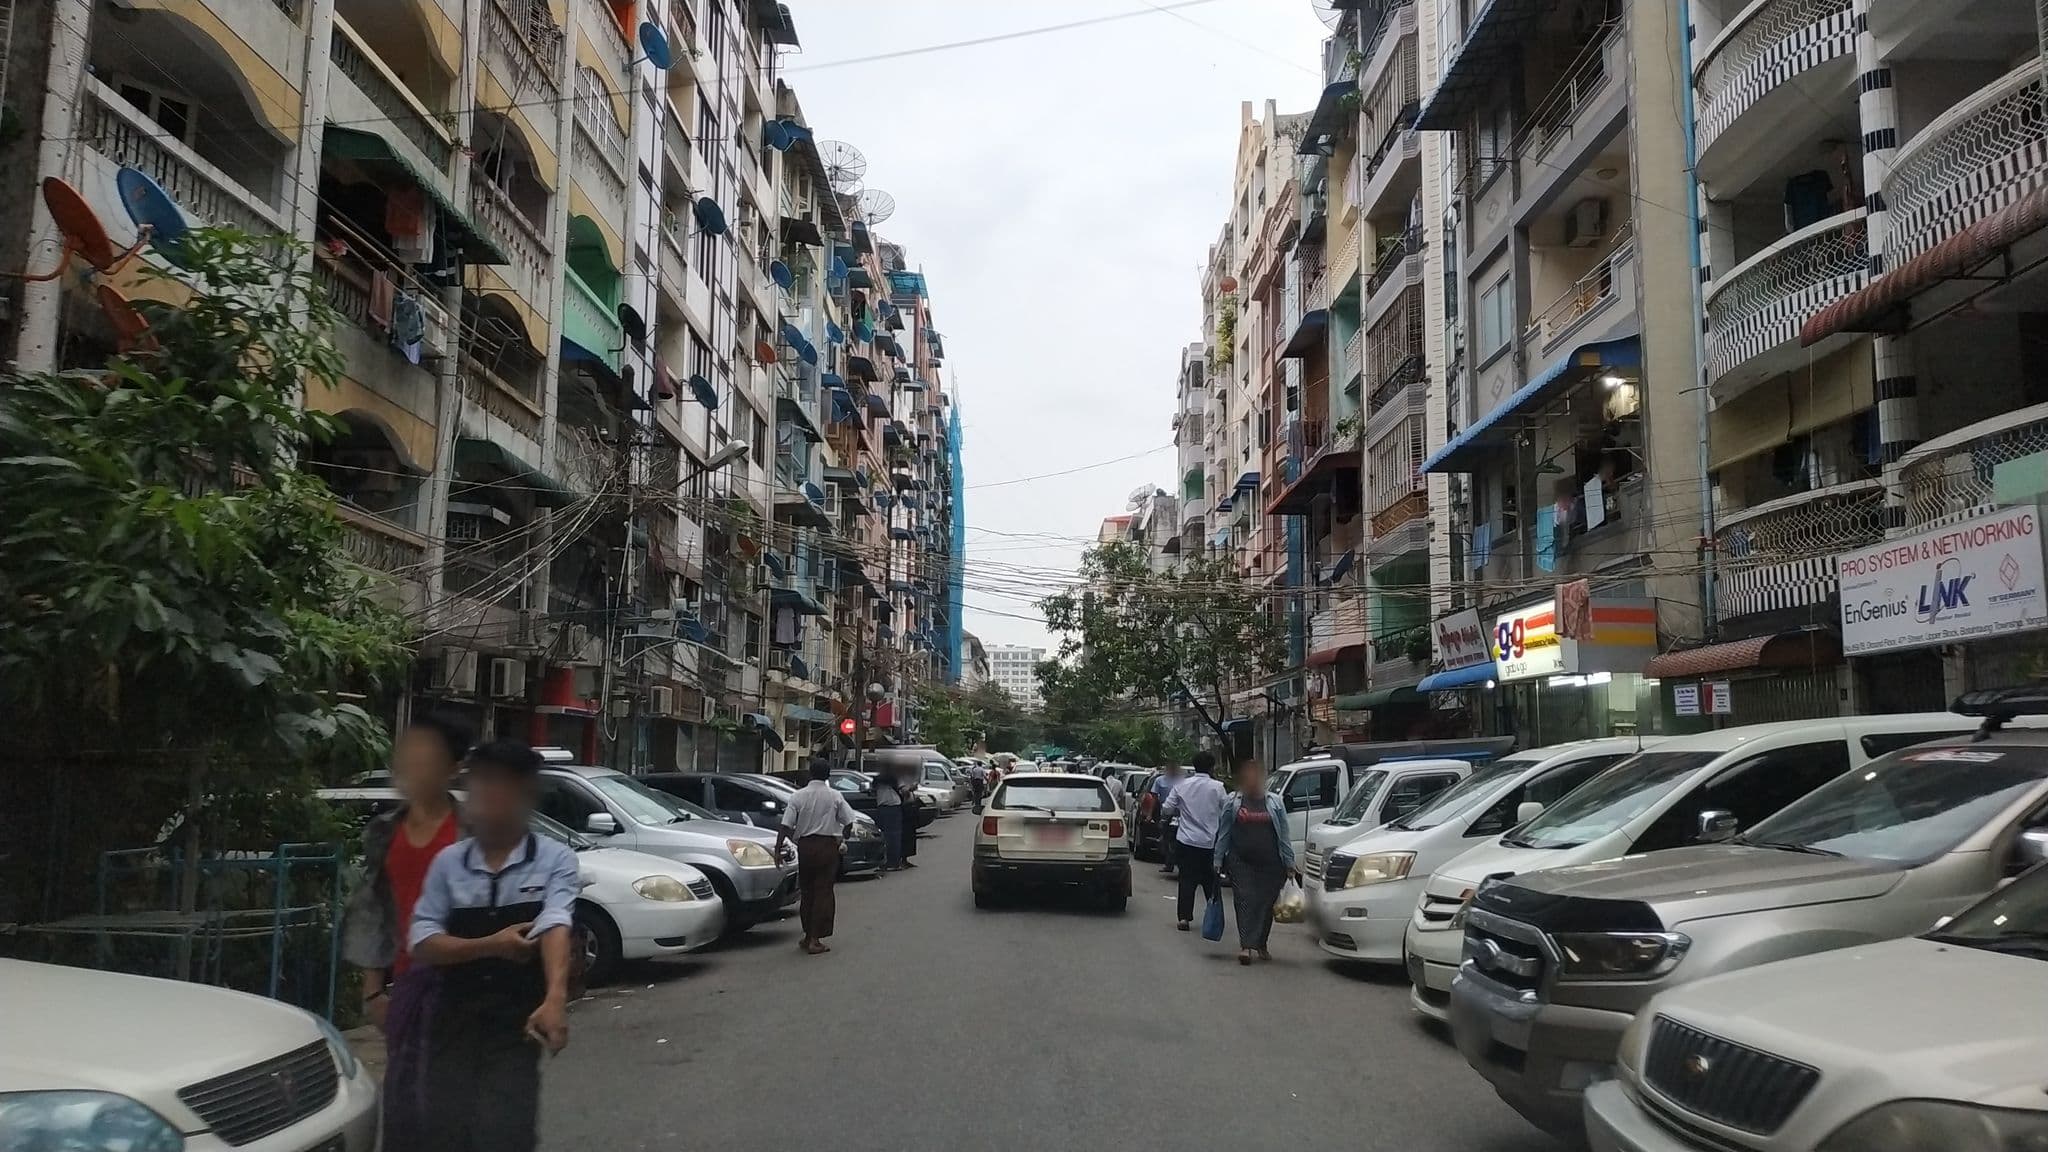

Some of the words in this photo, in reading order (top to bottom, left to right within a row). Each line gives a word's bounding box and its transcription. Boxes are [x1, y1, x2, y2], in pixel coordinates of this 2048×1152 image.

[1841, 559, 1866, 578] PRO
[1869, 545, 1919, 572] SYSTEM
[1921, 541, 1931, 560] &
[1932, 514, 2034, 557] NETWORKING
[1844, 599, 1907, 624] EnGenius
